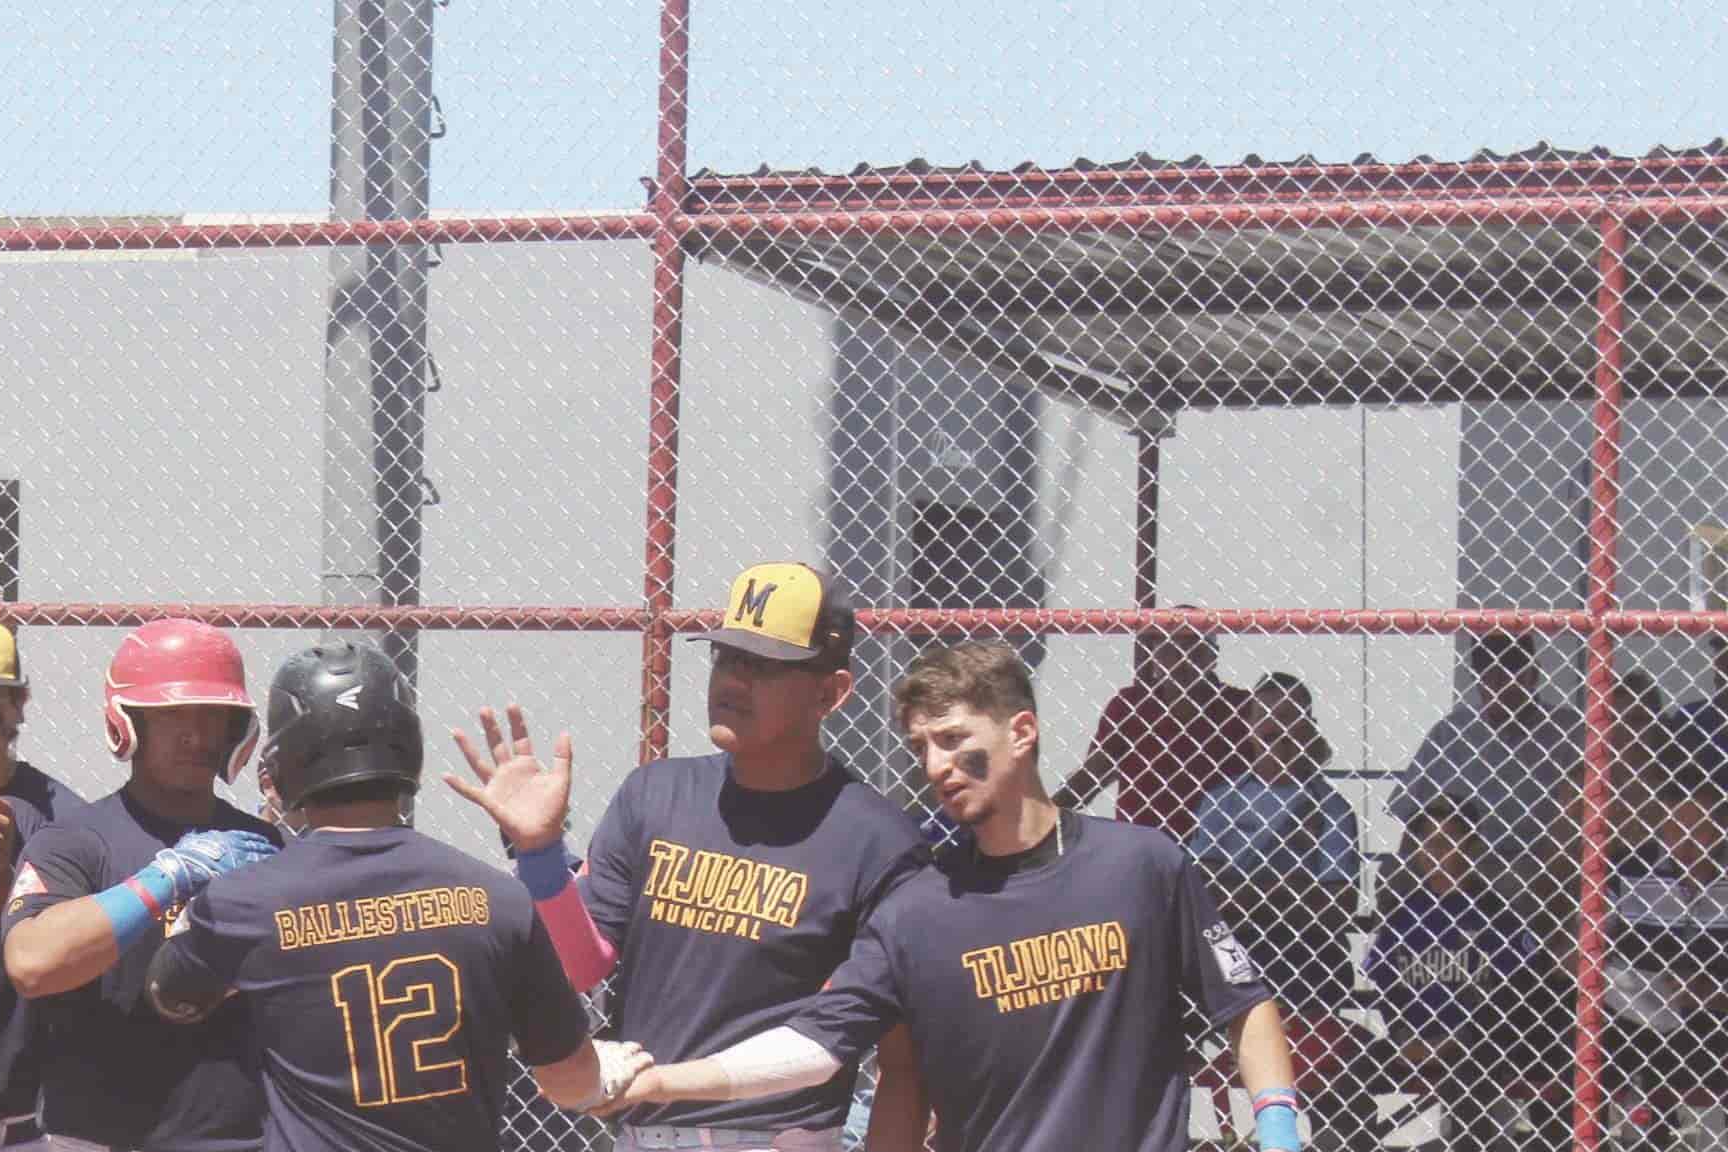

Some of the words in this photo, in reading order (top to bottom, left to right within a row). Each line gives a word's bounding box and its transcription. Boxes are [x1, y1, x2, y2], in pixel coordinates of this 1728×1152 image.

[734, 578, 778, 628] M
[643, 839, 808, 929] TIJUANA
[274, 886, 490, 950] BALLESTEROS
[649, 898, 762, 941] MUNICIPAL
[961, 920, 1129, 999] TIJUANA
[997, 974, 1105, 1014] MUNICIPAL
[330, 953, 469, 1108] 12
